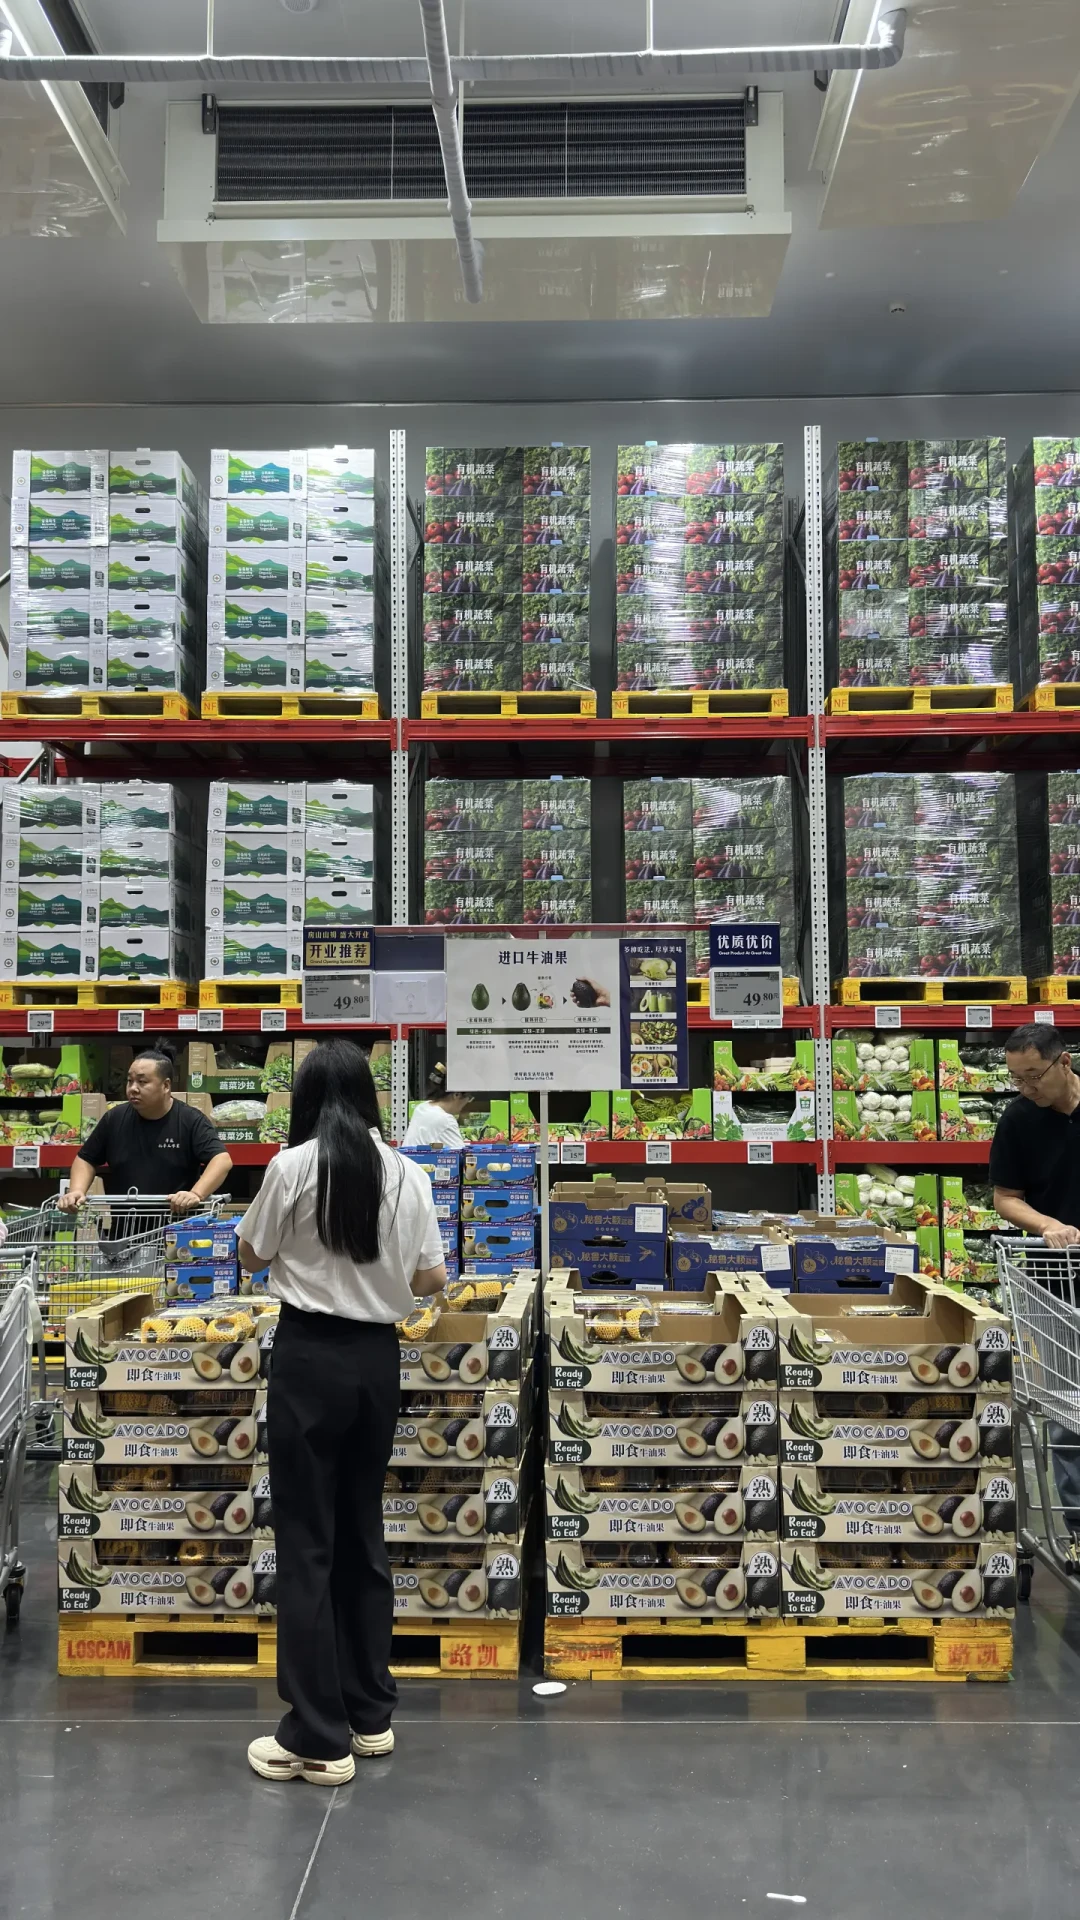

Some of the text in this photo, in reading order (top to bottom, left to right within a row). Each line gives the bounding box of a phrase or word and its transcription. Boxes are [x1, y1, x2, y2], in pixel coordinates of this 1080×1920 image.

[456, 463, 494, 476] 有机蔬菜
[542, 466, 576, 477] 有机蔬菜
[856, 462, 891, 472] 有机蔬菜
[456, 512, 494, 525] 有机蔬菜
[541, 516, 575, 526] 有机蔬菜
[716, 560, 754, 572] 有机蔬菜
[857, 561, 891, 571] 有机蔬菜
[940, 555, 978, 565] 有机蔬菜
[455, 561, 493, 573] 有机蔬菜
[940, 604, 979, 614] 有机蔬菜
[455, 609, 493, 622] 有机蔬菜
[455, 659, 493, 671] 有机蔬菜
[540, 663, 574, 673] 有机蔬菜
[717, 658, 754, 671] 有机蔬菜
[857, 659, 892, 668] 有机蔬菜
[456, 798, 493, 810] 有机蔬菜
[540, 800, 575, 811] 有机蔬菜
[641, 801, 676, 812] 有机蔬菜
[725, 844, 764, 857] 有机蔬菜
[456, 897, 494, 909] 有机蔬菜
[726, 895, 765, 907] 有机蔬菜
[717, 935, 772, 949] 优质优价
[310, 944, 367, 958] 开业推荐
[499, 951, 567, 964] 进口牛油果
[220, 1081, 255, 1090] 蔬菜沙拉
[496, 1330, 514, 1348] 熟
[752, 1330, 770, 1348] 熟
[986, 1330, 1004, 1348] 熟
[118, 1348, 191, 1361] AVOCADO
[602, 1351, 675, 1364] AVOCADO
[832, 1351, 907, 1364] AVOCADO
[70, 1368, 97, 1380] Ready
[126, 1368, 181, 1382] 即食牛油果
[555, 1368, 582, 1379] Ready
[611, 1370, 666, 1384] 即食牛油果
[785, 1367, 813, 1378] Ready
[842, 1370, 898, 1384] 即食牛油果
[81, 1378, 95, 1387] Eat
[555, 1378, 581, 1387] To Eat
[798, 1377, 812, 1386] Eat
[494, 1406, 512, 1424] 熟
[753, 1404, 771, 1422] 熟
[987, 1406, 1005, 1424] 熟
[115, 1424, 188, 1437] AVOCADO
[602, 1424, 676, 1437] AVOCADO
[833, 1426, 908, 1439] AVOCADO
[67, 1440, 94, 1451] Ready
[124, 1444, 178, 1458] 即食牛油果
[555, 1442, 582, 1453] Ready
[611, 1444, 666, 1458] 即食牛油果
[786, 1442, 814, 1454] Ready
[79, 1450, 92, 1459] Eat
[555, 1453, 581, 1462] To Eat
[798, 1453, 813, 1462] Eat
[843, 1446, 899, 1460] 即食牛油果
[494, 1482, 512, 1500] 熟
[752, 1479, 771, 1497] 熟
[991, 1481, 1010, 1498] 熟
[111, 1499, 184, 1511] AVOCADO
[600, 1500, 674, 1512] AVOCADO
[836, 1502, 911, 1515] AVOCADO
[63, 1515, 90, 1526] Ready
[120, 1518, 174, 1532] 即食牛油果
[552, 1516, 580, 1528] Ready
[609, 1519, 664, 1533] 即食牛油果
[789, 1518, 817, 1529] Ready
[75, 1525, 89, 1534] Eat
[552, 1527, 579, 1537] To Eat
[801, 1528, 816, 1538] Eat
[846, 1521, 902, 1535] 即食牛油果
[496, 1558, 514, 1575] 熟
[753, 1555, 772, 1574] 熟
[991, 1556, 1010, 1575] 熟
[111, 1573, 185, 1585] AVOCADO
[600, 1574, 675, 1588] AVOCADO
[835, 1576, 911, 1590] AVOCADO
[62, 1589, 90, 1600] Ready
[120, 1592, 175, 1606] 即食牛油果
[552, 1593, 581, 1605] Ready
[788, 1593, 816, 1604] Ready
[74, 1599, 88, 1609] Eat
[610, 1594, 666, 1608] 即食牛油果
[845, 1596, 901, 1610] 即食牛油果
[553, 1604, 579, 1613] To Eat
[788, 1604, 815, 1613] To Eat
[67, 1640, 131, 1660] LOSCAM
[448, 1643, 498, 1667] 路凯
